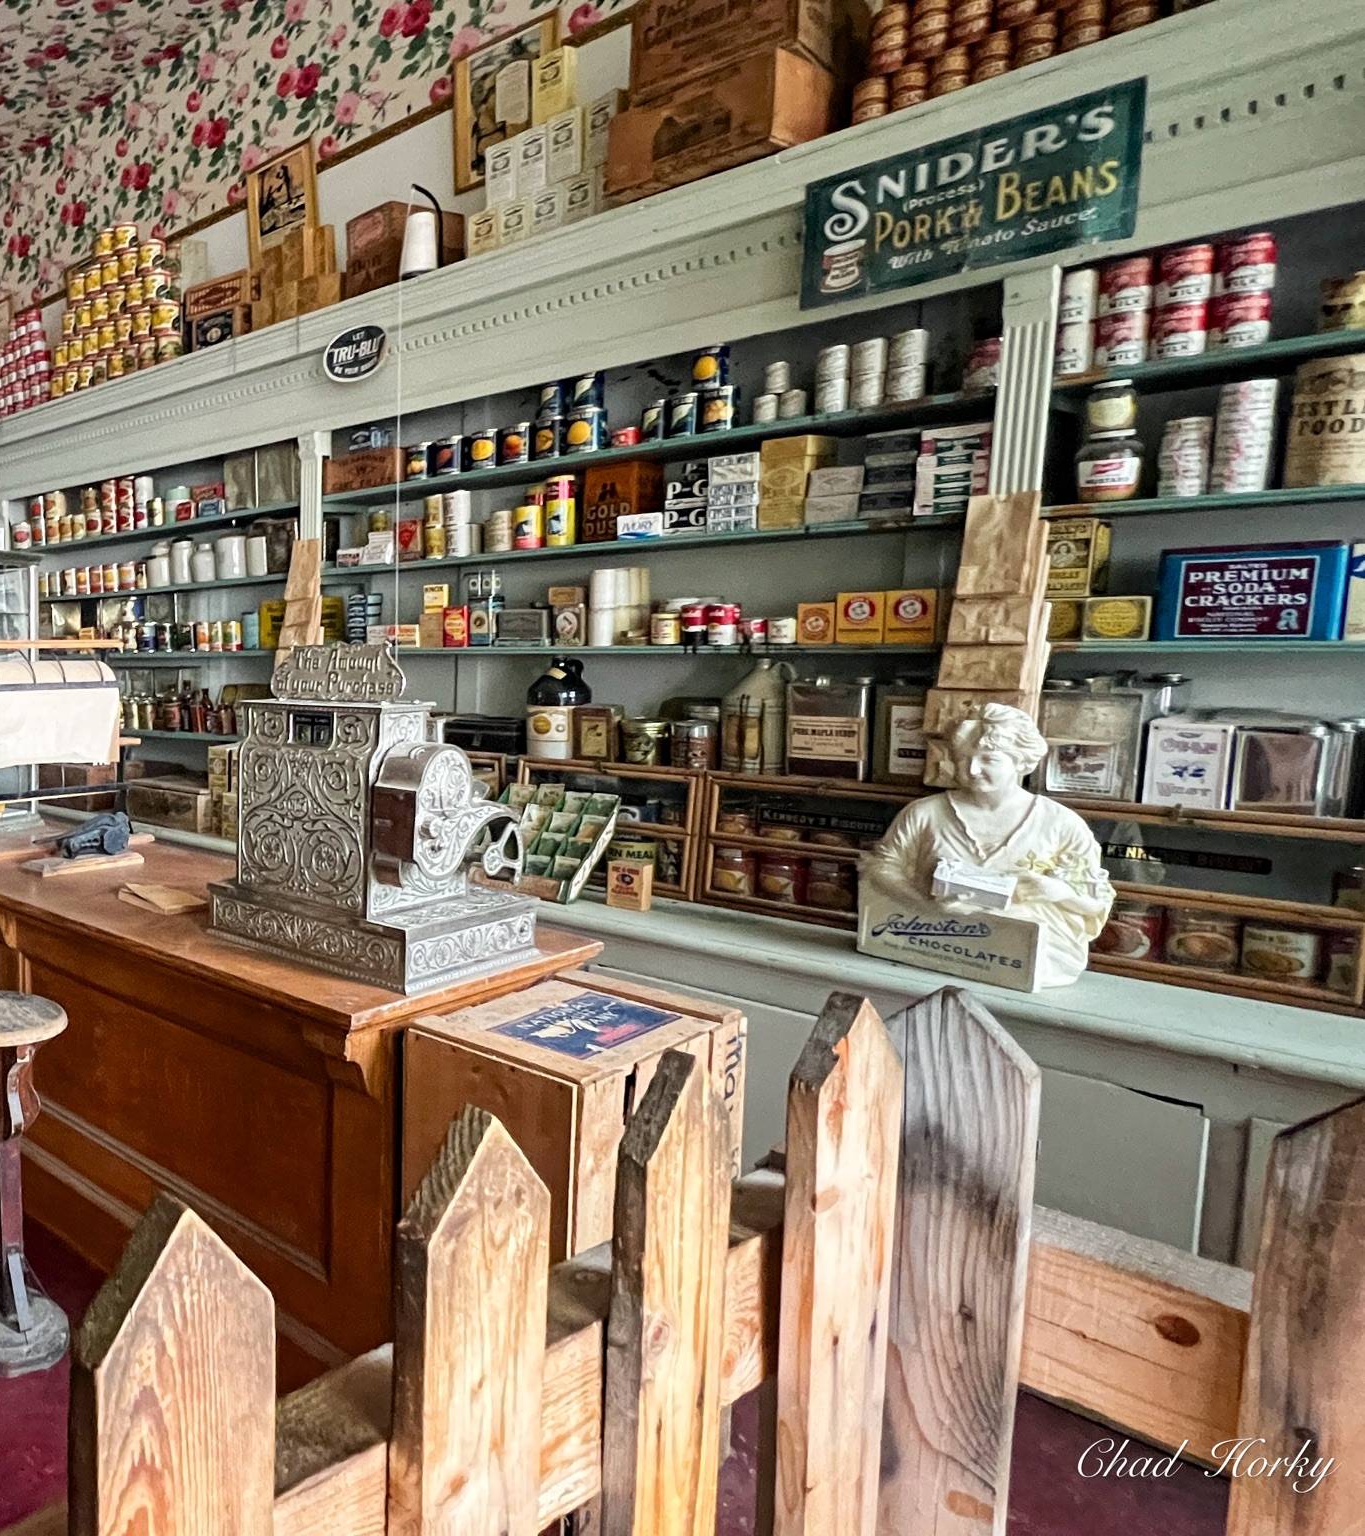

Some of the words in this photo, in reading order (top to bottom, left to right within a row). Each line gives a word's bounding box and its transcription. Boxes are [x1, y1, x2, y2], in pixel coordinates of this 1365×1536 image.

[824, 105, 1116, 241] SNIDER'S
[874, 205, 953, 250] PORK
[995, 160, 1120, 222] BEANS
[903, 178, 986, 213] (Process)
[887, 249, 934, 270] With
[1169, 287, 1203, 298] MILK
[1109, 298, 1141, 309] MILK
[328, 332, 385, 364] TRU-BLU
[1107, 353, 1139, 362] MILK
[666, 479, 708, 500] P-G
[586, 502, 631, 521] GOLD
[664, 508, 706, 529] P-G
[585, 519, 618, 536] DUS
[621, 520, 654, 532] IVORY
[1188, 567, 1311, 584] PREMIUM
[1212, 581, 1278, 596] SODA
[1184, 592, 1309, 607] CRACKERS
[295, 649, 321, 674] The
[326, 649, 381, 675] Amount
[291, 678, 322, 696] your
[326, 671, 395, 699] Purchase
[626, 849, 655, 859] MEAL
[871, 913, 992, 938] Johnston's
[908, 936, 1023, 970] CHOCOLATES
